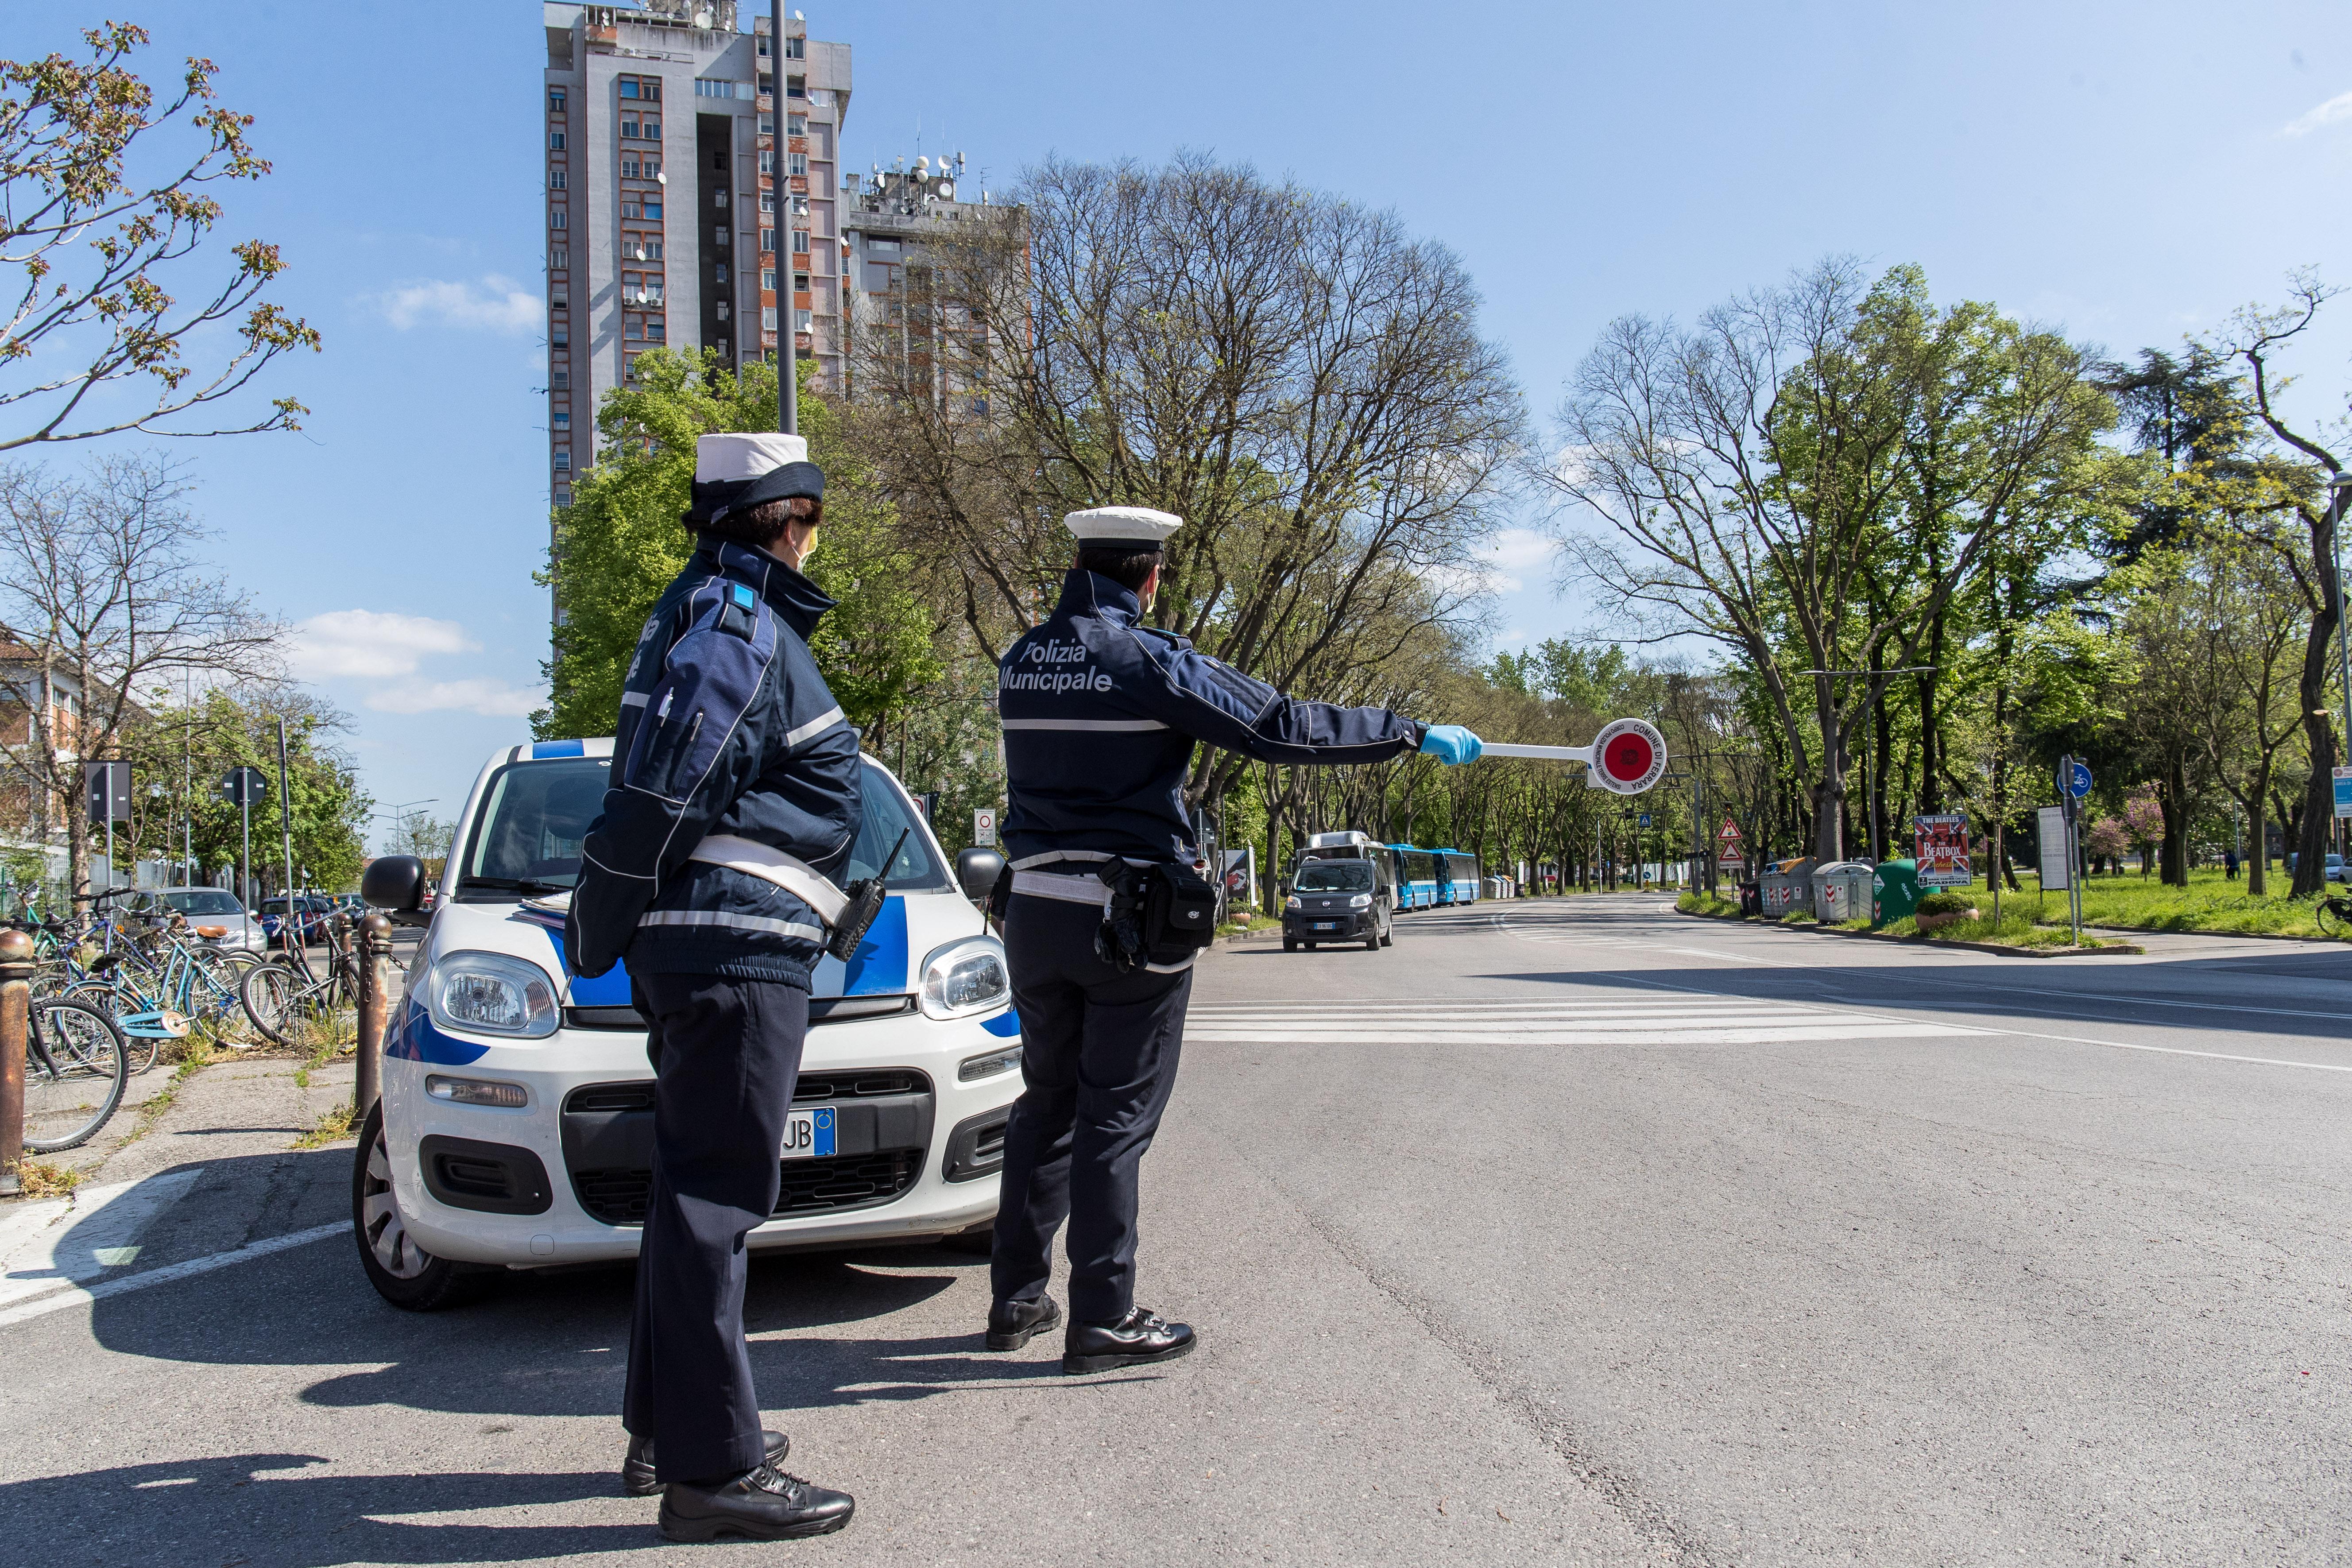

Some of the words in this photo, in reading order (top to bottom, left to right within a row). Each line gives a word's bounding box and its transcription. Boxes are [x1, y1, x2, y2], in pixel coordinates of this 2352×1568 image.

[1019, 638, 1086, 663] Polizia
[1001, 666, 1112, 694] Municipale
[1599, 731, 1612, 744] POLIZIA
[1610, 724, 1625, 734] CORPO
[1633, 724, 1661, 749] COMUNE
[1598, 767, 1608, 781] TERRE
[1631, 762, 1661, 790] FERRARA
[1605, 778, 1621, 790] ESTENSI
[1923, 842, 1961, 859] BEATBOX
